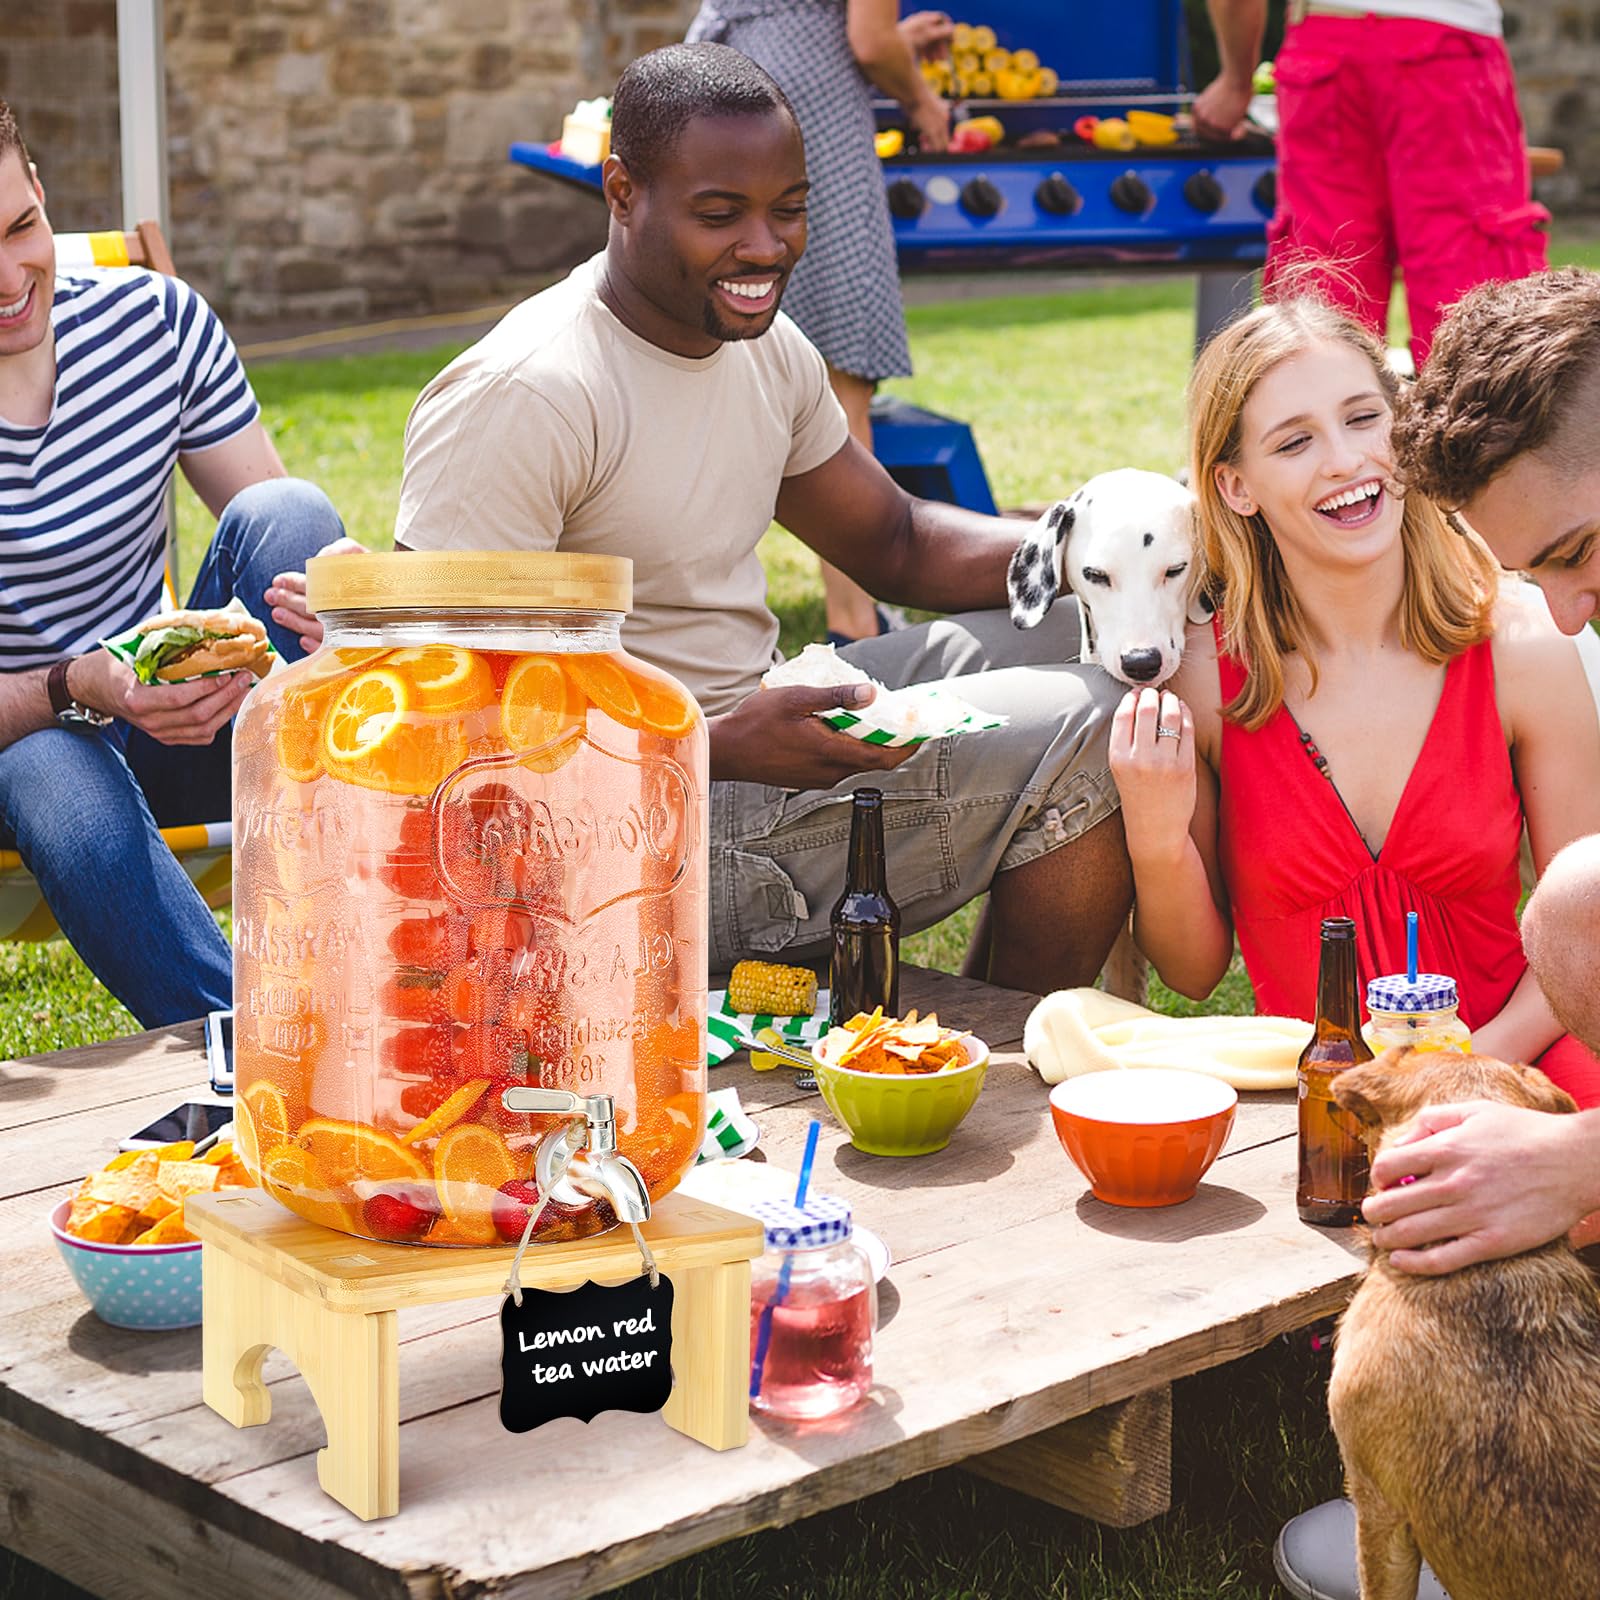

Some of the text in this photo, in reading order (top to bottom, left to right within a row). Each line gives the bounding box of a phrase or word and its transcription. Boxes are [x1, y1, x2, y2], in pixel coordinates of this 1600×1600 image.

[518, 1307, 657, 1353] Lemon red
[531, 1349, 658, 1384] tea water
